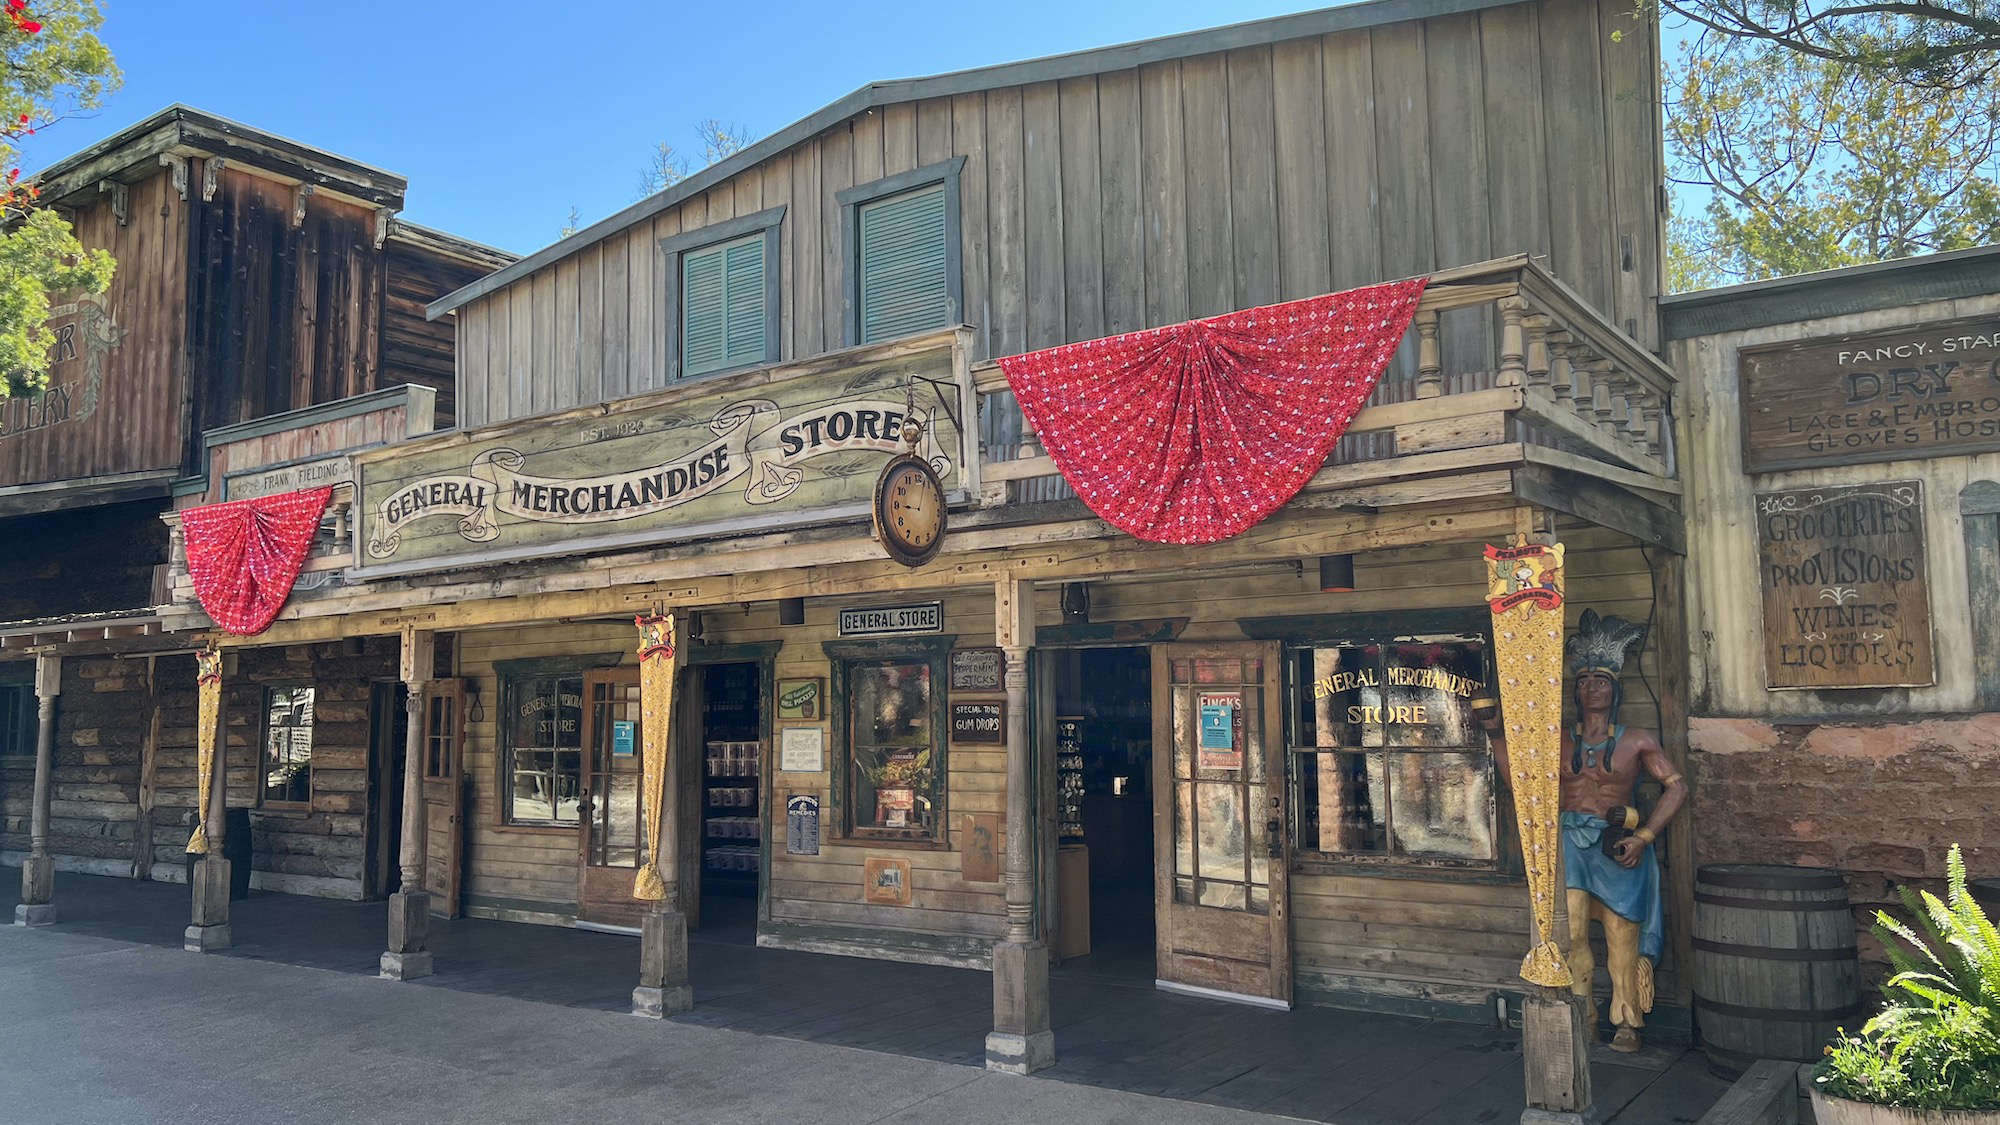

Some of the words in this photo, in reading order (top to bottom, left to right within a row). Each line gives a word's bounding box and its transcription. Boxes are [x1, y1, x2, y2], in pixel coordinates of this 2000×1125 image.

[1838, 341, 1933, 366] FANCY.
[1847, 361, 1960, 406] DRY
[580, 425, 610, 443] EST.
[1787, 412, 1859, 434] LACE
[1867, 409, 1888, 428] &
[1808, 426, 1920, 452] GLOVES
[1934, 419, 2000, 442] HOS
[264, 473, 289, 490] FRANK
[298, 462, 338, 483] FIELDING
[387, 481, 488, 525] GENERAL
[511, 444, 732, 515] MERCHANDISE
[781, 410, 904, 458] STORE
[1767, 499, 1914, 543] GROCERIES
[1772, 544, 1915, 587] PROVISIONS
[845, 611, 895, 630] GENERAL
[900, 609, 935, 626] STORE
[1793, 602, 1899, 633] WINES
[1780, 641, 1915, 669] LIQUORS
[962, 674, 996, 686] STICKS
[520, 693, 558, 718] GENERAL
[956, 705, 982, 715] SPECIAL
[1347, 705, 1428, 725] STORE
[956, 718, 975, 731] GUM
[975, 717, 1000, 732] DROPS
